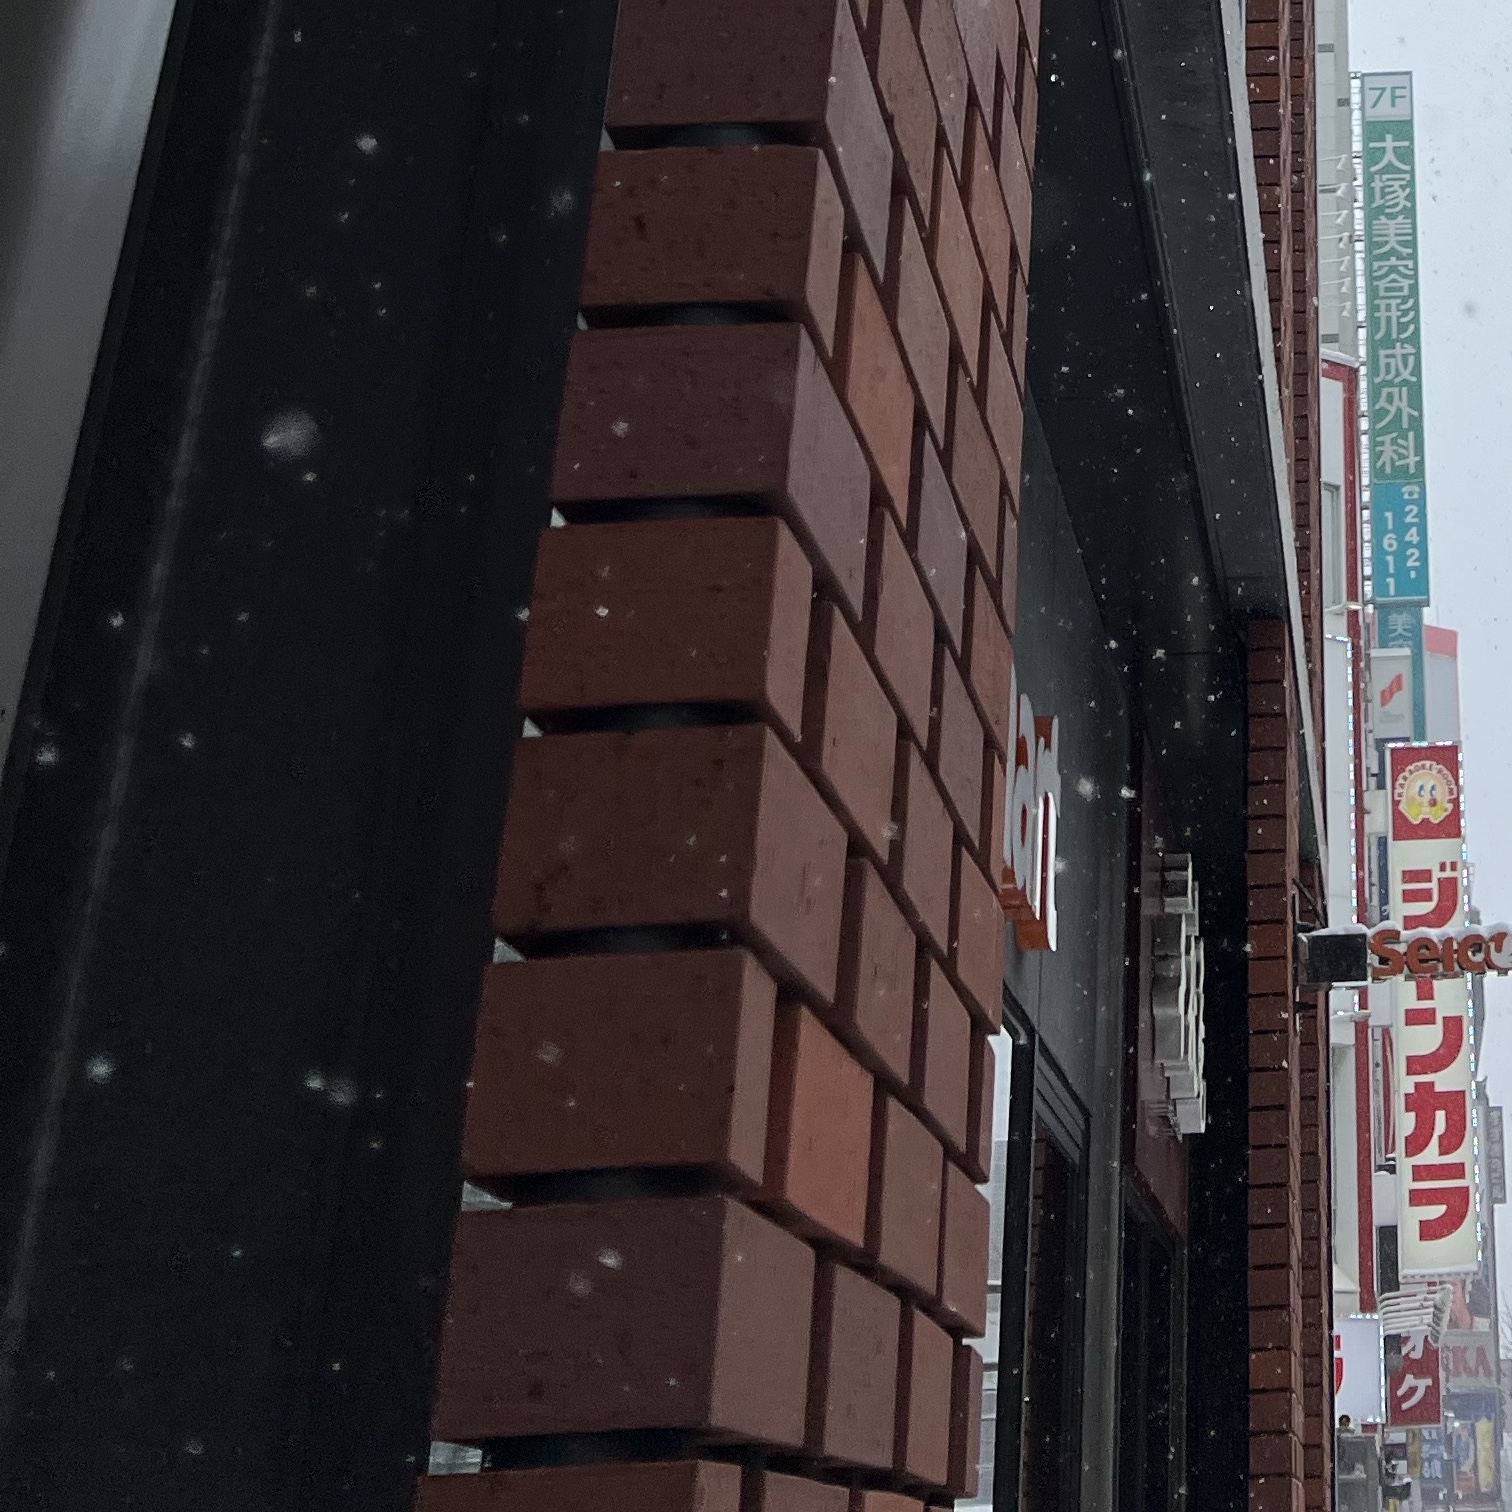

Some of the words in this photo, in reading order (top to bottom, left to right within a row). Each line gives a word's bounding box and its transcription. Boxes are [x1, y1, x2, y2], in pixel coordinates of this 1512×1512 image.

[1368, 86, 1408, 110] 7F
[1368, 133, 1421, 476] 大塚美容形成外科
